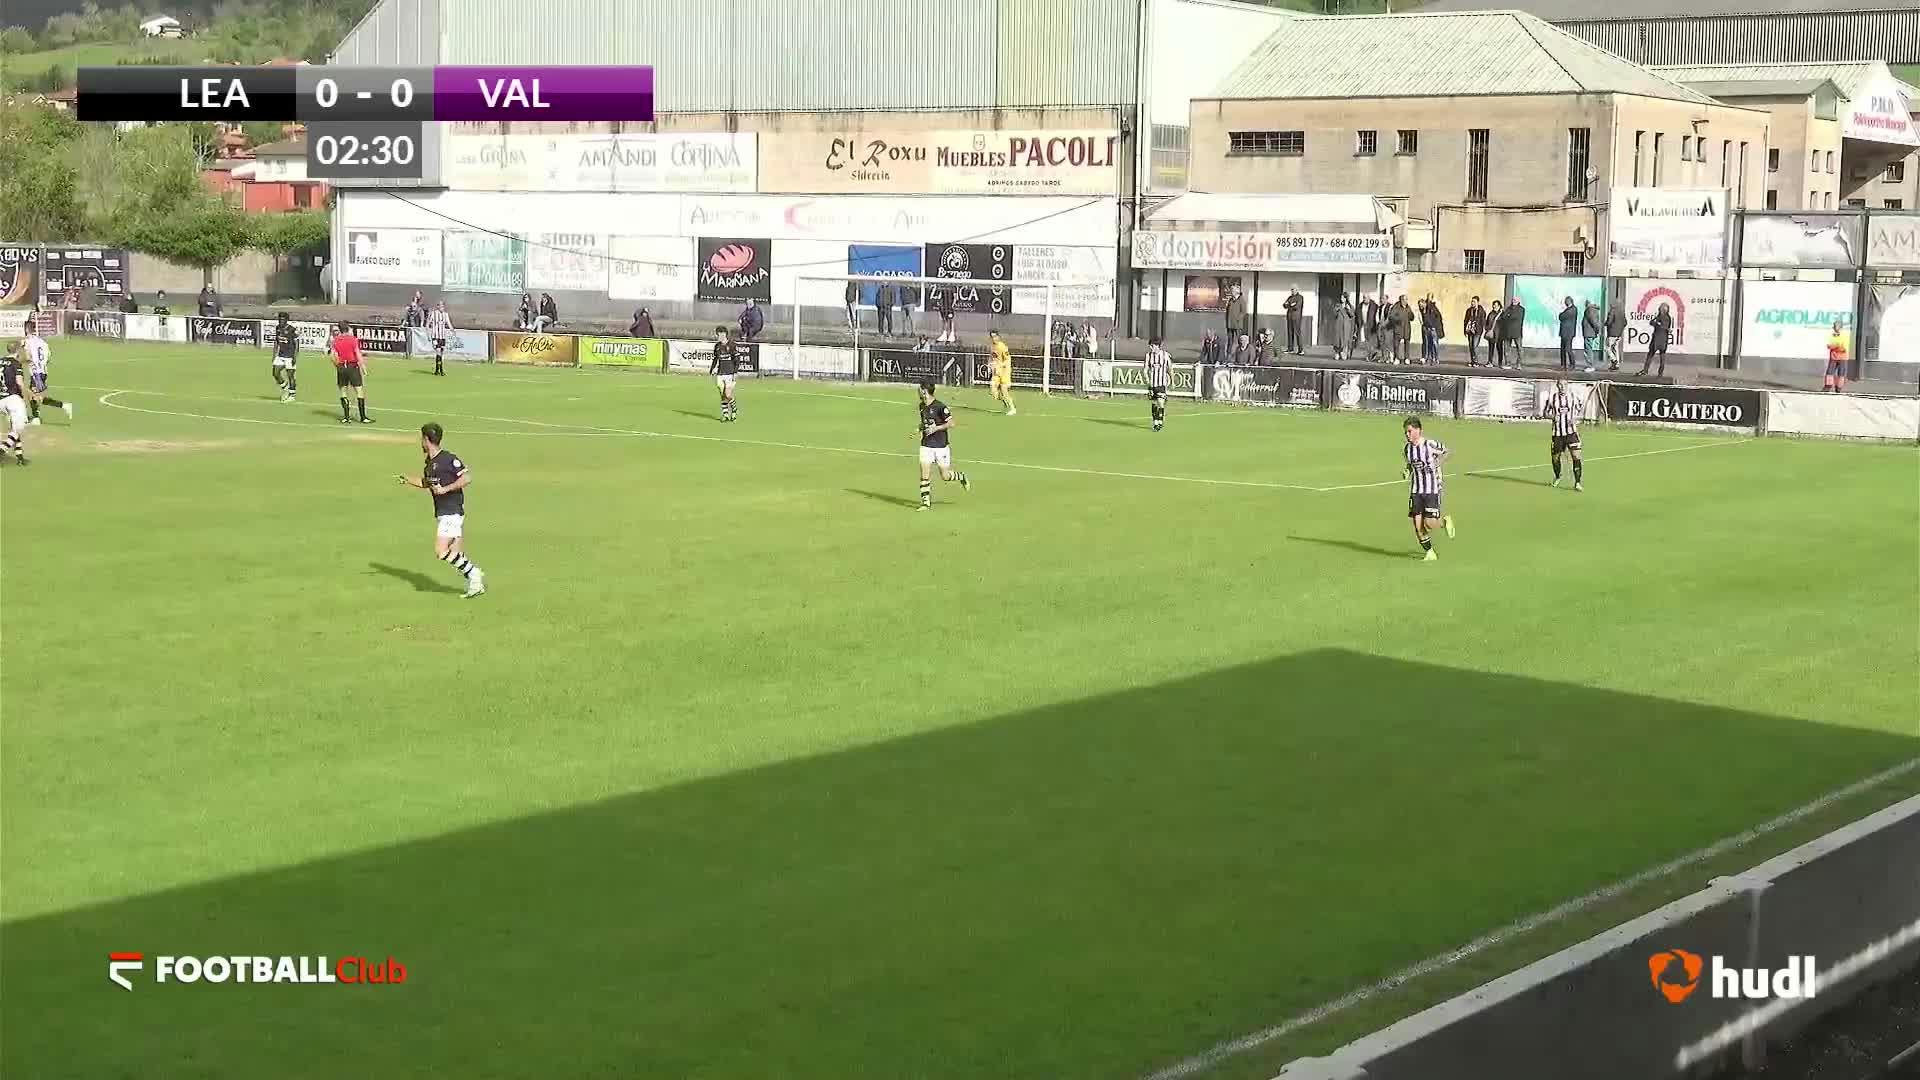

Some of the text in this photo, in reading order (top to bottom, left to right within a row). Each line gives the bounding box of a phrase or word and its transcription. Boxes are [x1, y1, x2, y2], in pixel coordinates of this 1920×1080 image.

[826, 137, 926, 171] El Roxu
[936, 146, 1006, 168] MUEBLES
[1276, 237, 1291, 248] 985
[1292, 237, 1307, 248] 891
[1310, 237, 1325, 248] 777
[1330, 238, 1346, 249] 684
[1347, 239, 1363, 249] 602
[1365, 239, 1380, 249] 199
[700, 267, 769, 288] MARIÑANA
[591, 341, 647, 357] minymas
[1381, 385, 1426, 402] Ballera
